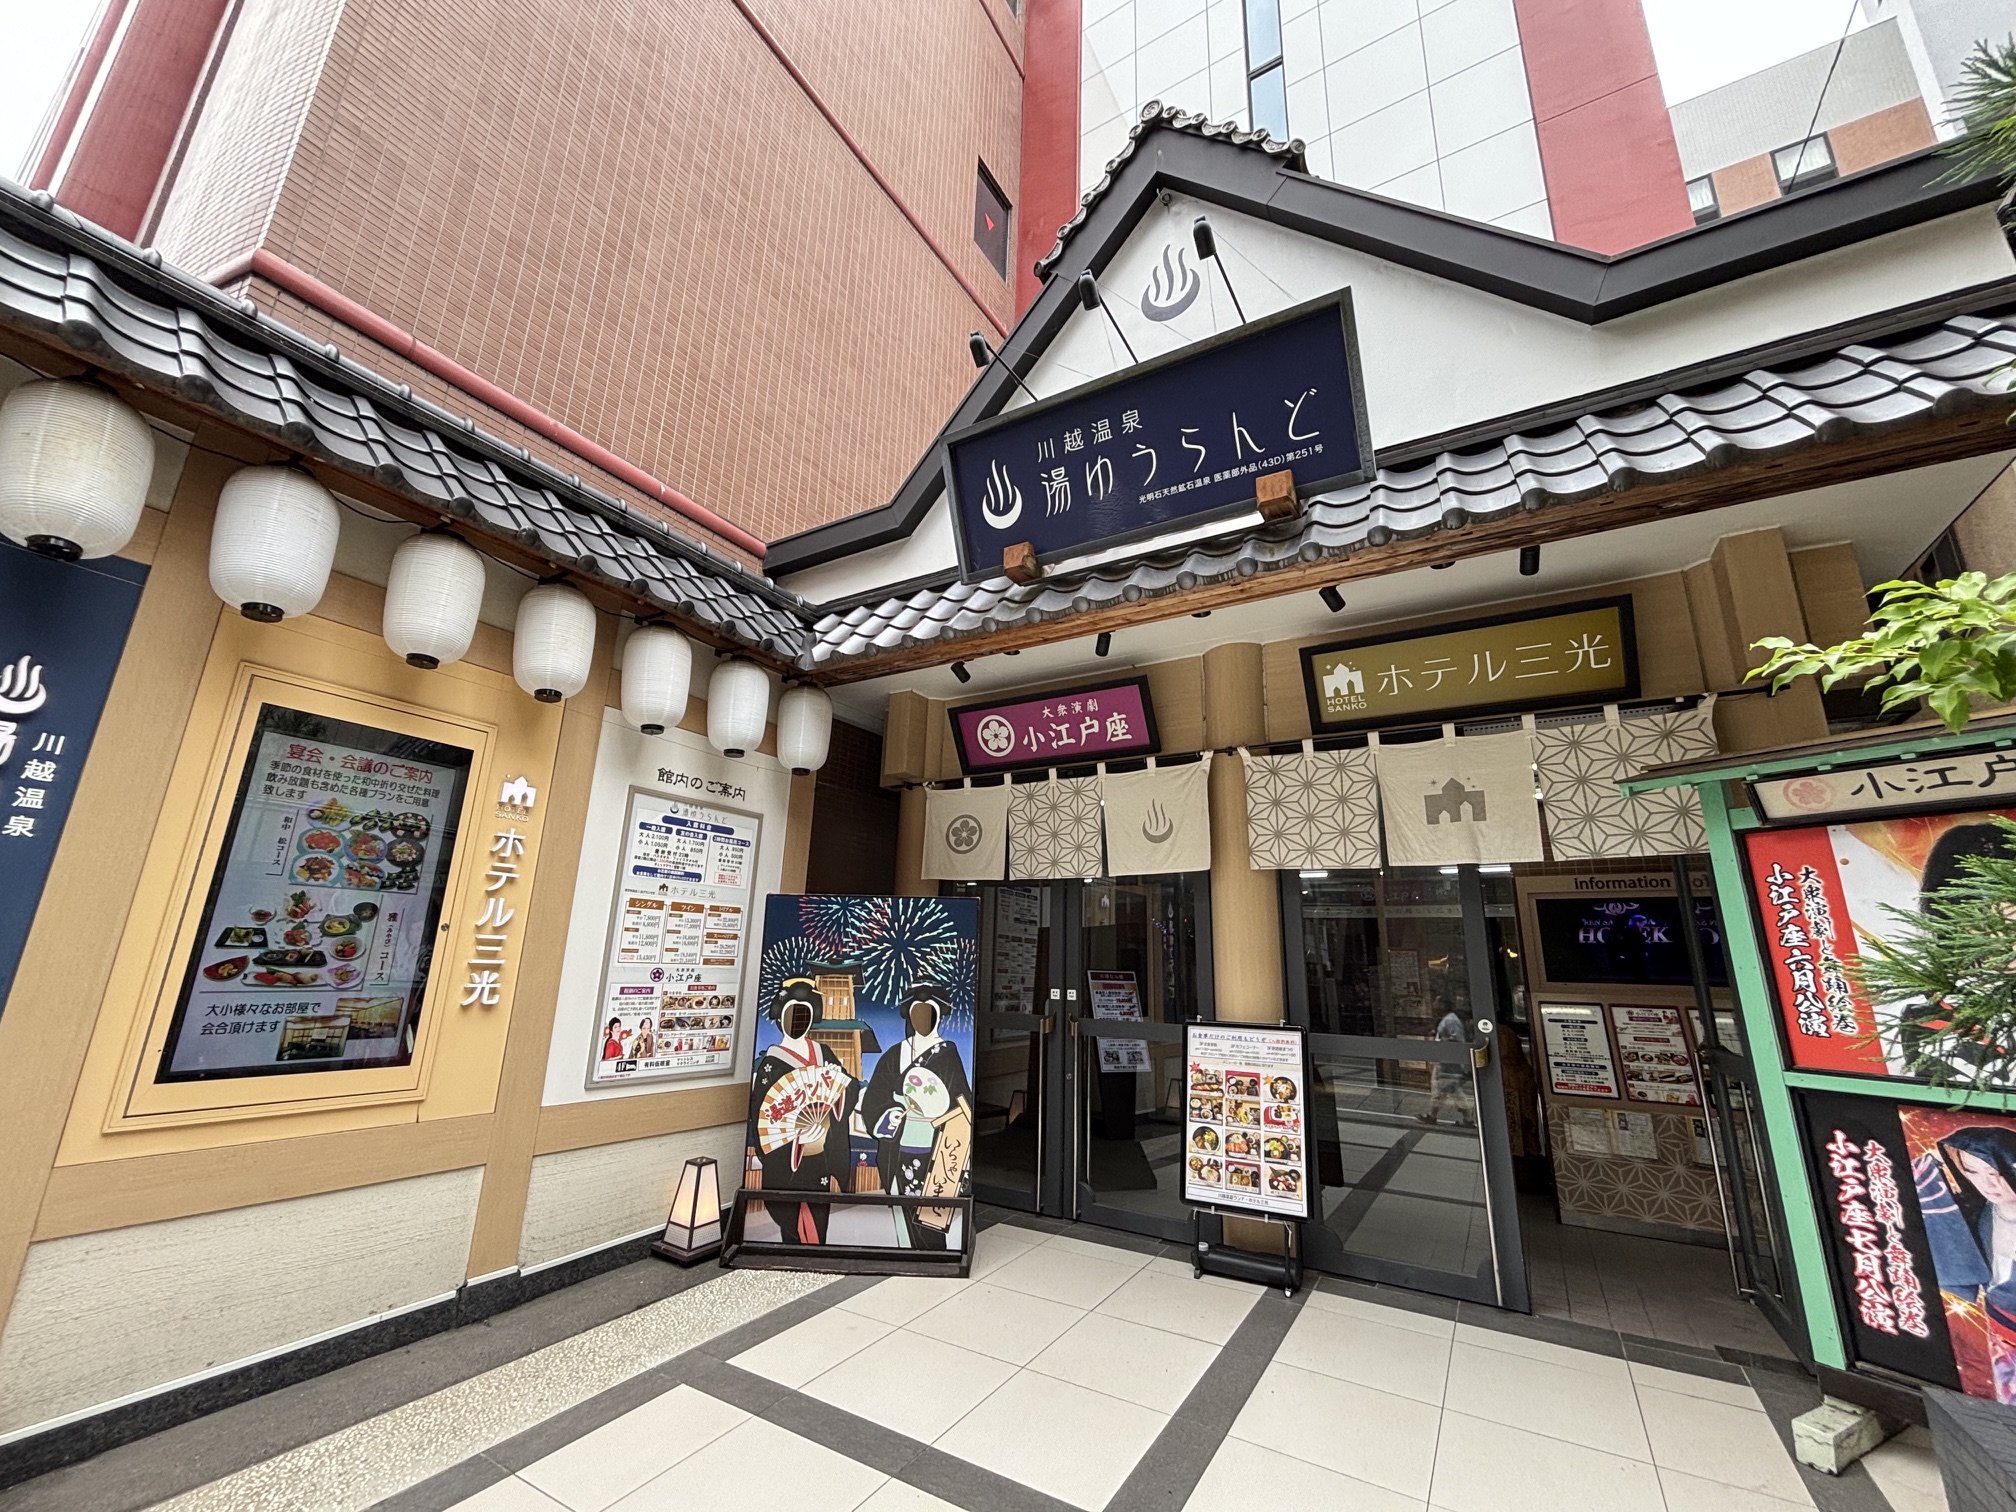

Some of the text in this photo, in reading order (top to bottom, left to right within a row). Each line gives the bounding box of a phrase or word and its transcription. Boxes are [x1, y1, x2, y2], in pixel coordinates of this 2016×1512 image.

[1037, 409, 1143, 463] 川越温泉
[1040, 388, 1320, 518] 湯ゆうらんど
[1377, 633, 1611, 695] ホテル三光
[1042, 698, 1099, 719] 大衆演劇
[1327, 694, 1365, 706] HOTEL
[1327, 701, 1367, 713] SANKO
[1022, 711, 1133, 753] 小江戸座
[286, 743, 433, 785] 宴会・会議のご案内
[2, 732, 66, 838] 川越温泉
[262, 784, 308, 800] 致します
[265, 771, 430, 808] 飲み放題も含めた各種プランをご用意
[656, 767, 747, 802] 館内のご案内
[494, 811, 530, 823] SANKO
[1573, 876, 1671, 890] information
[460, 828, 526, 1007] ホテル三光
[375, 951, 389, 981] コース
[1765, 861, 1832, 1038] 小江戸座六月公演
[204, 1001, 321, 1017] 大小様々なお部屋で
[200, 1020, 281, 1036] 会合頂けます
[764, 1069, 832, 1125] 湯遊ランド
[1825, 1128, 1899, 1337] 小江戸座七月公演
